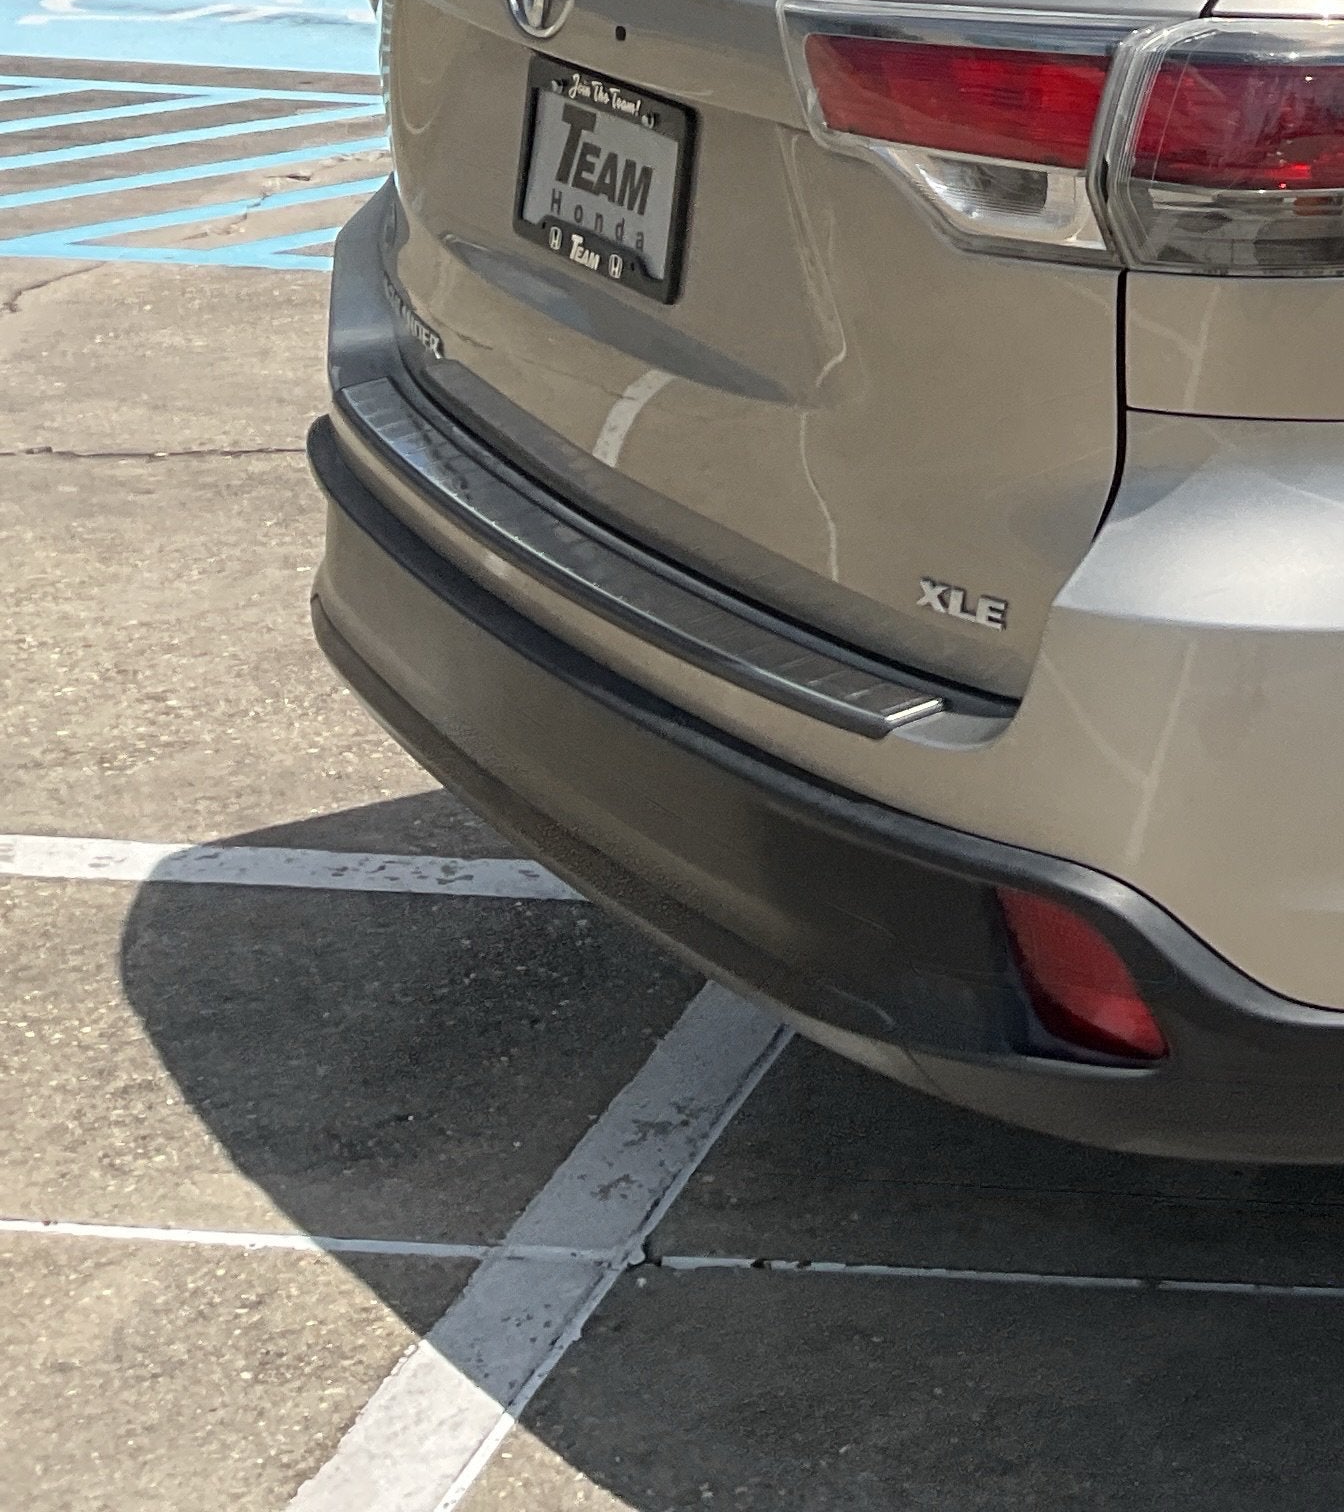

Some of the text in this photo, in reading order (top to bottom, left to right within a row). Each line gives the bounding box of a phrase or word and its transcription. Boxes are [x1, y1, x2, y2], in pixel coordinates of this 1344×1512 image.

[568, 73, 641, 117] Join The Team!
[554, 103, 653, 216] TEAM
[550, 188, 645, 253] Honda
[569, 233, 601, 271] TEAM
[916, 577, 1008, 631] XLE
